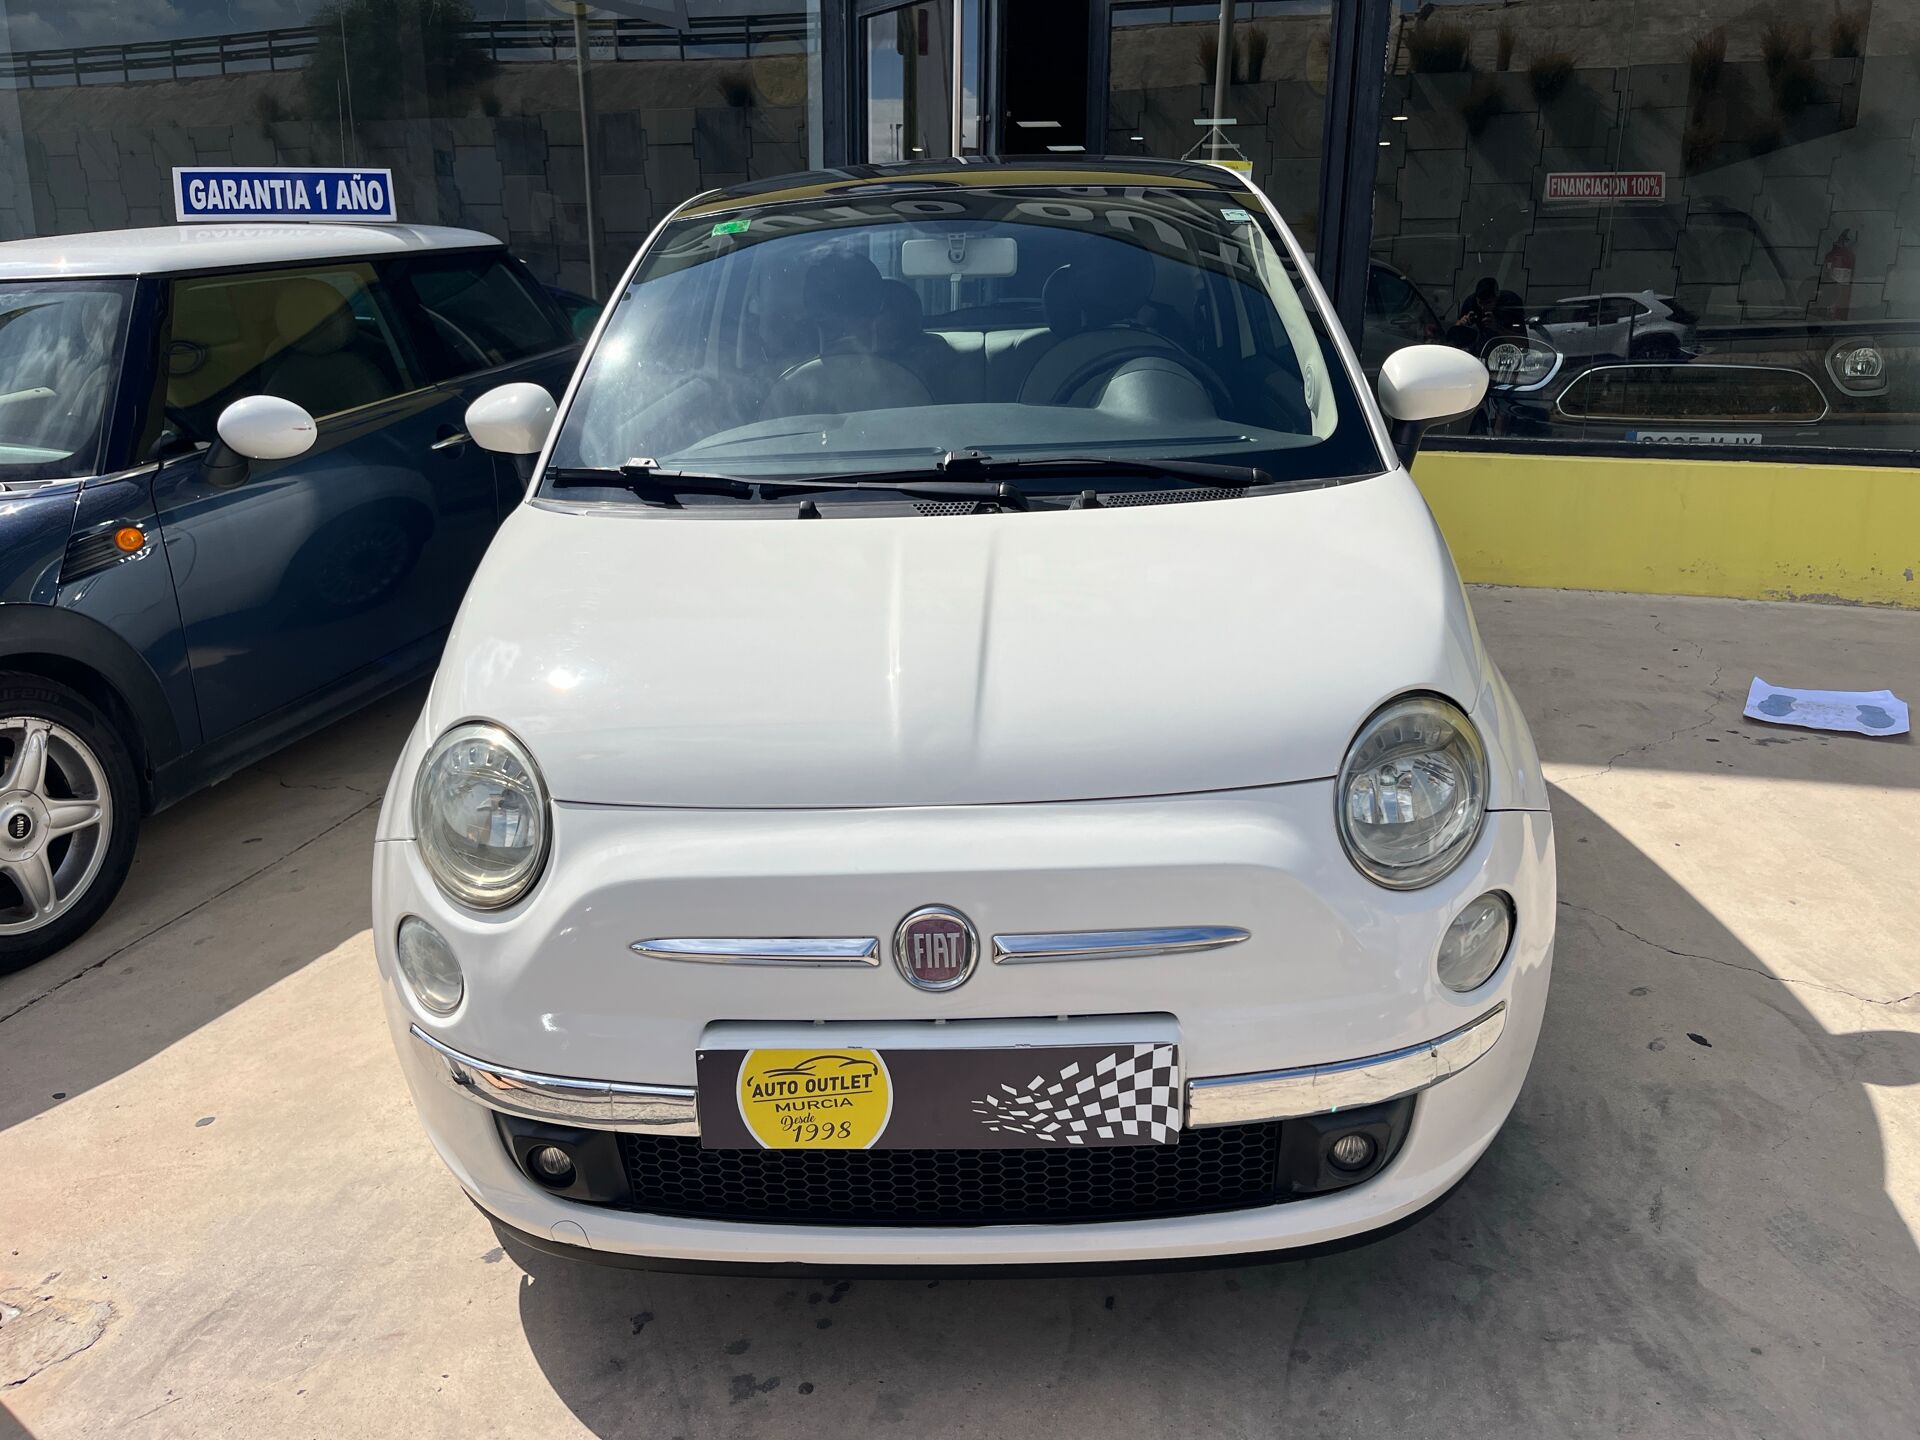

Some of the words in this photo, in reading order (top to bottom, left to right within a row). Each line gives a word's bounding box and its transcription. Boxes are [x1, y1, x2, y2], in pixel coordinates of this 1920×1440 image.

[189, 179, 311, 210] GARANTIA
[315, 180, 328, 210] 1
[336, 173, 384, 211] AÑO
[1551, 176, 1628, 196] FINANCIACION
[1631, 176, 1660, 196] 100%
[16, 815, 25, 837] MINI
[913, 932, 961, 969] FIAT
[752, 1080, 799, 1099] AUTO
[805, 1073, 873, 1093] OUTLET
[775, 1097, 854, 1113] MURCIA
[780, 1112, 817, 1132] Desde
[792, 1120, 853, 1143] 1998
